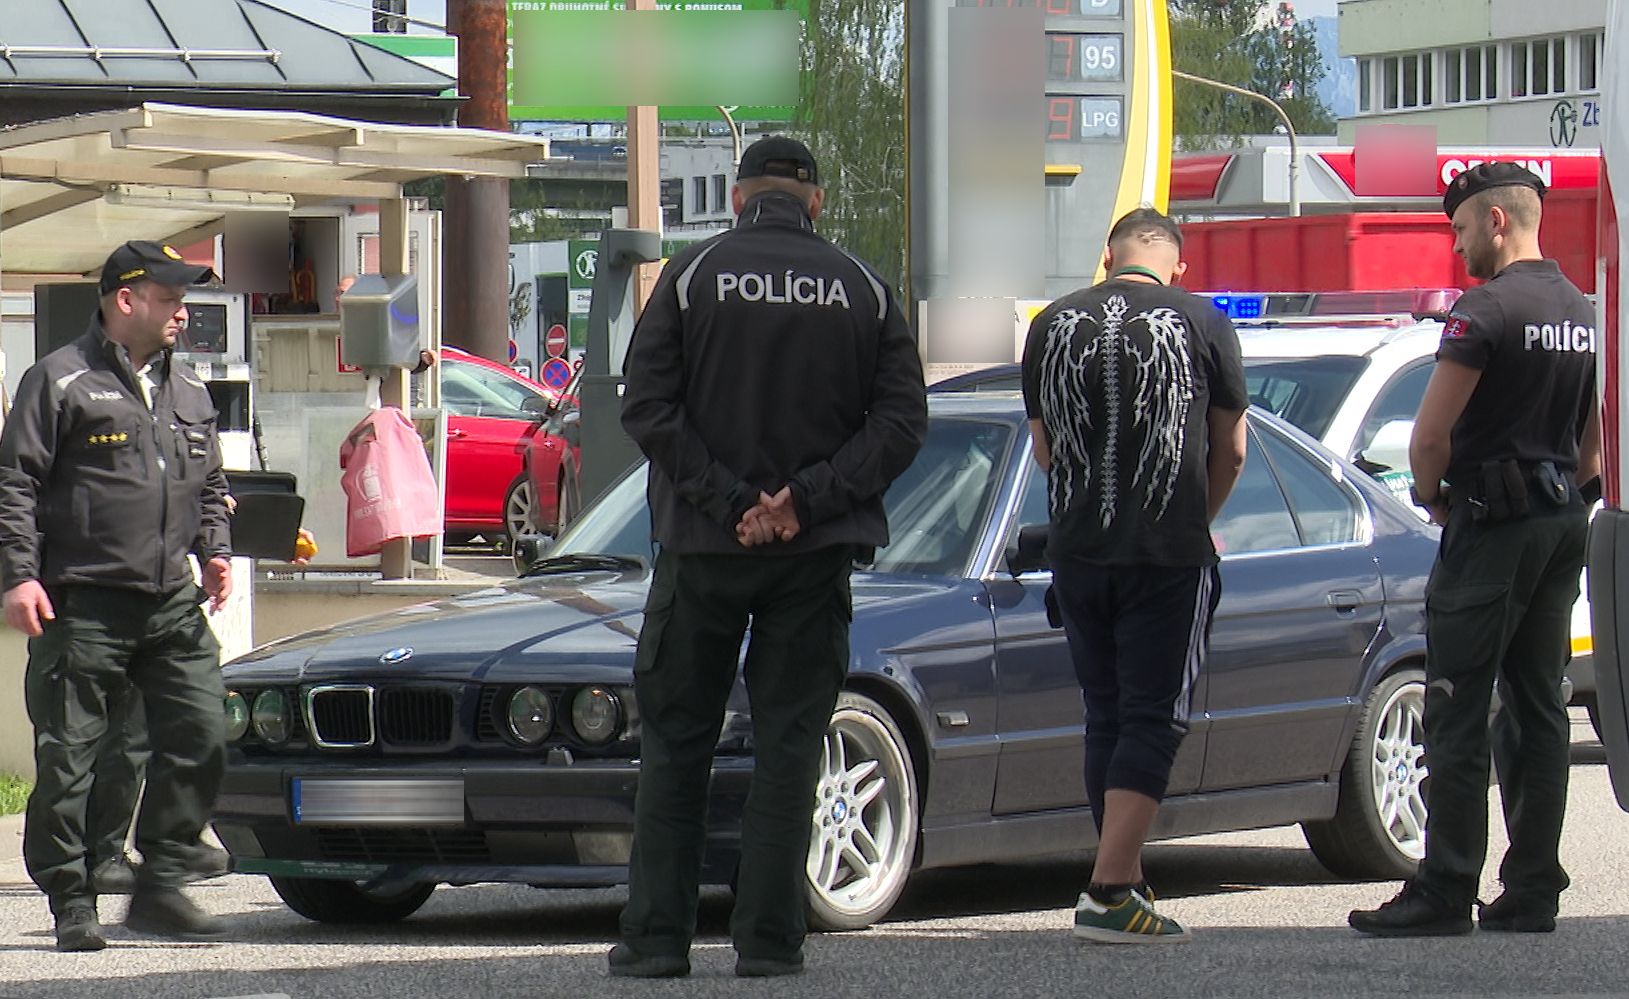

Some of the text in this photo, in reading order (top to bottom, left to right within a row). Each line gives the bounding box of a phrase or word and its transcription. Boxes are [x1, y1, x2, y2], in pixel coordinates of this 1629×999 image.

[1085, 46, 1115, 69] 95
[1082, 112, 1118, 127] LPG
[716, 270, 850, 309] POLÍCIA
[1523, 320, 1595, 353] POLÍCI
